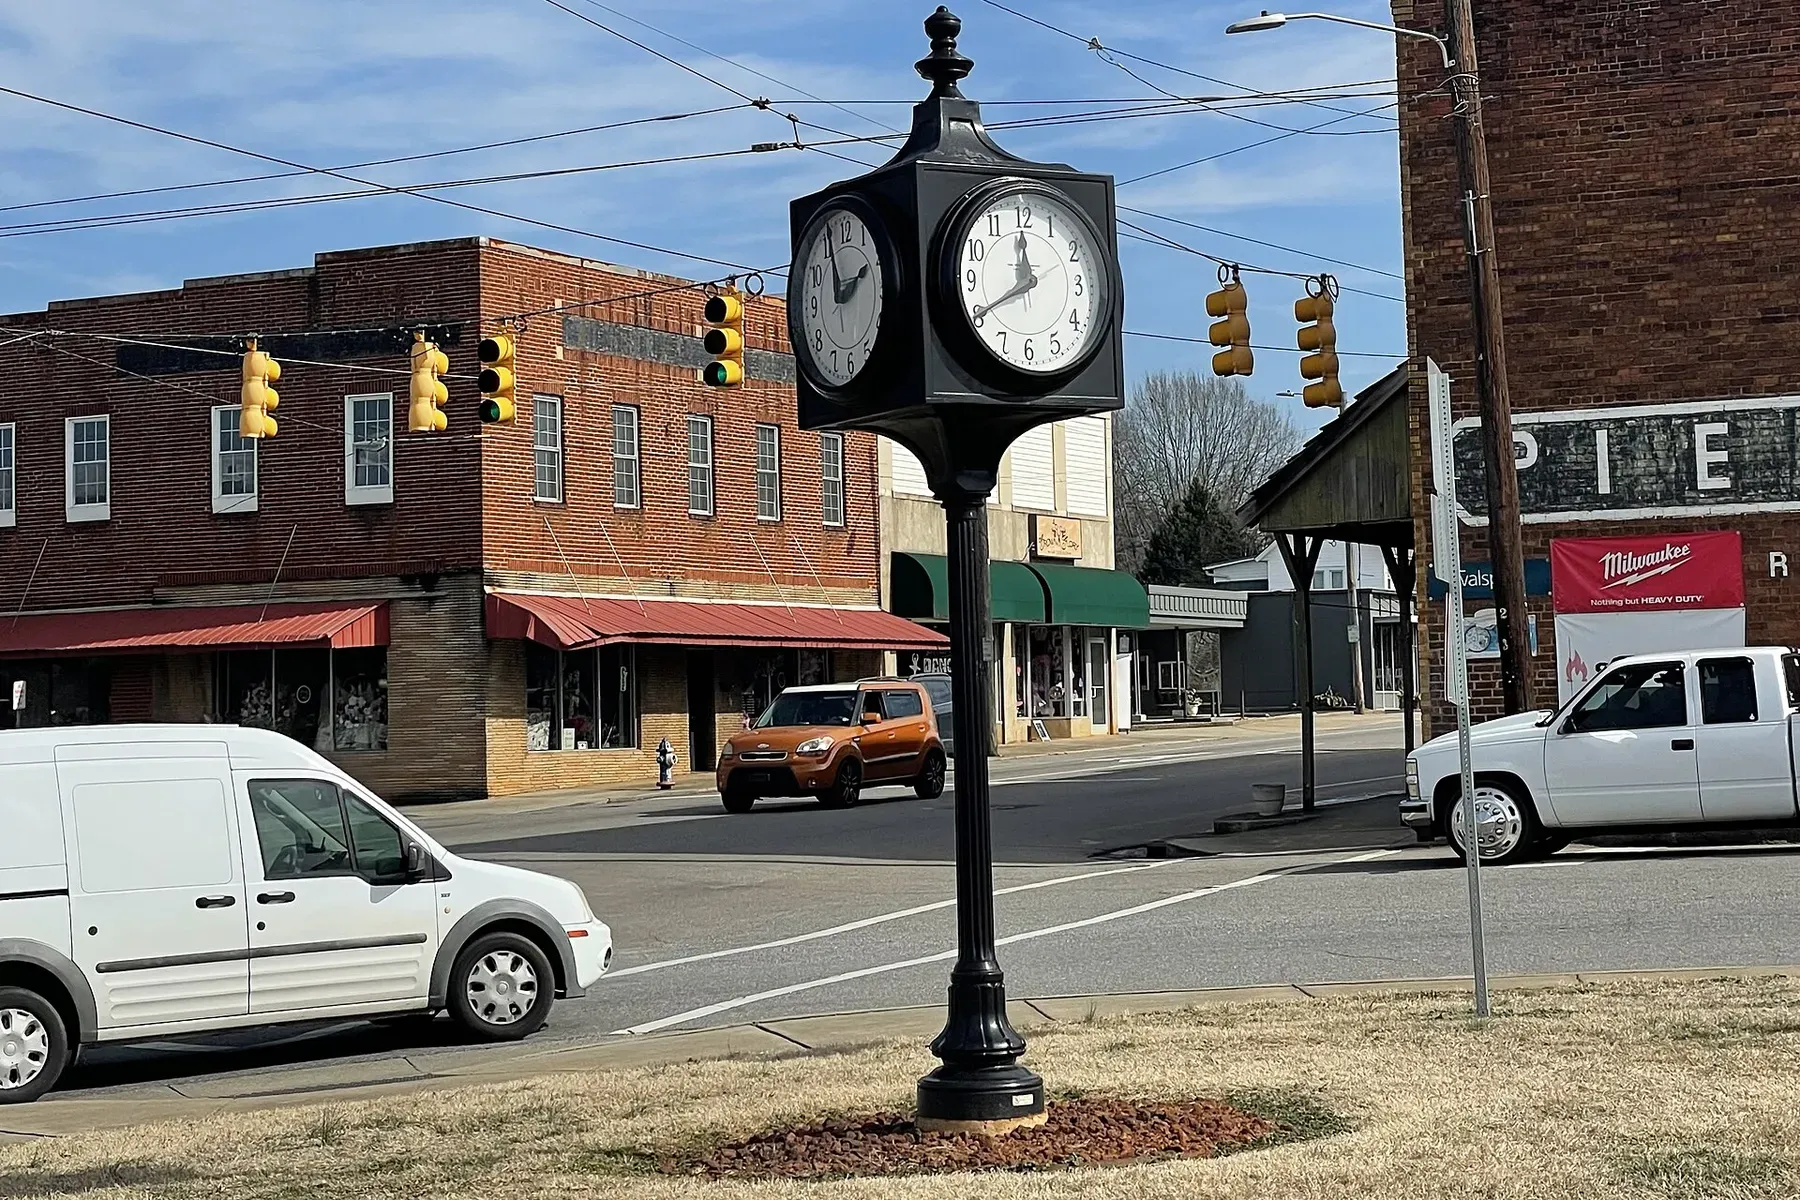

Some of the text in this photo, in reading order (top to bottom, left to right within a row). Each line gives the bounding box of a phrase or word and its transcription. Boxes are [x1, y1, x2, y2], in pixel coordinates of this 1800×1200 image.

[986, 214, 1001, 237] 11
[1014, 206, 1033, 229] 12
[1047, 215, 1054, 238] 1
[840, 220, 852, 245] 12
[860, 224, 866, 247] 1
[967, 238, 985, 262] 10
[1068, 240, 1079, 263] 2
[811, 264, 823, 289] 10
[966, 269, 977, 292] 9
[1073, 274, 1083, 297] 3
[810, 295, 818, 319] 9
[972, 304, 985, 328] 8
[1068, 308, 1080, 332] 4
[815, 328, 823, 352] 8
[995, 331, 1011, 355] 7
[1023, 338, 1034, 361] 6
[1049, 331, 1061, 355] 5
[829, 349, 839, 373] 7
[847, 351, 855, 375] 6
[1598, 543, 1691, 580] Milwaukee
[1769, 551, 1788, 577] R
[1499, 607, 1508, 619] 2
[1590, 598, 1624, 607] Nothing
[1625, 597, 1639, 605] but
[1641, 596, 1674, 604] HEAVY
[923, 657, 952, 673] DANC
